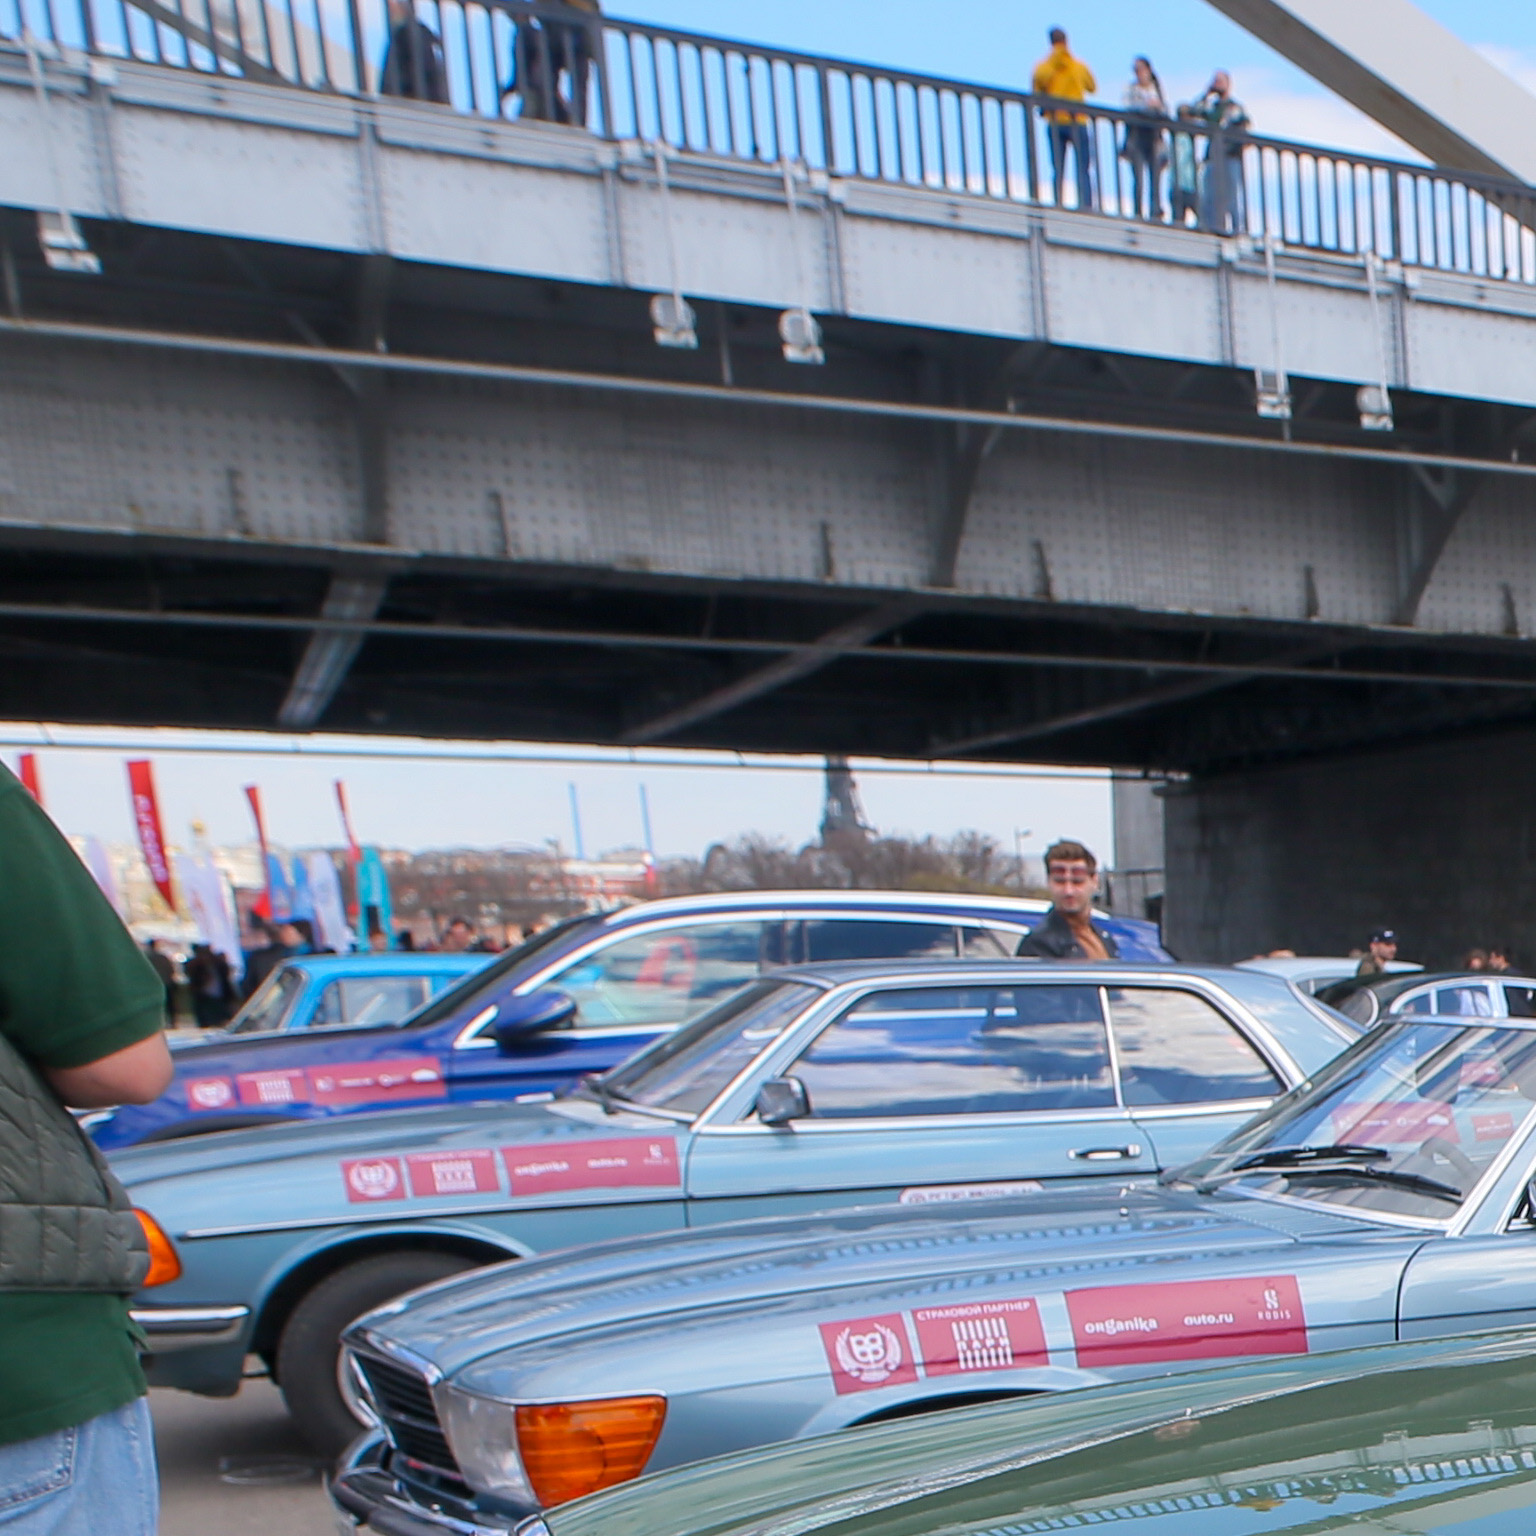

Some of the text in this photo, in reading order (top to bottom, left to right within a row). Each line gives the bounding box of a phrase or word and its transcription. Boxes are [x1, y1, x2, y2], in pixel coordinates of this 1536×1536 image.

[917, 1300, 1031, 1321] СТРАХОВОЙ ПАРТНЕР
[1183, 1312, 1234, 1327] auto.ru
[1084, 1316, 1158, 1336] organika
